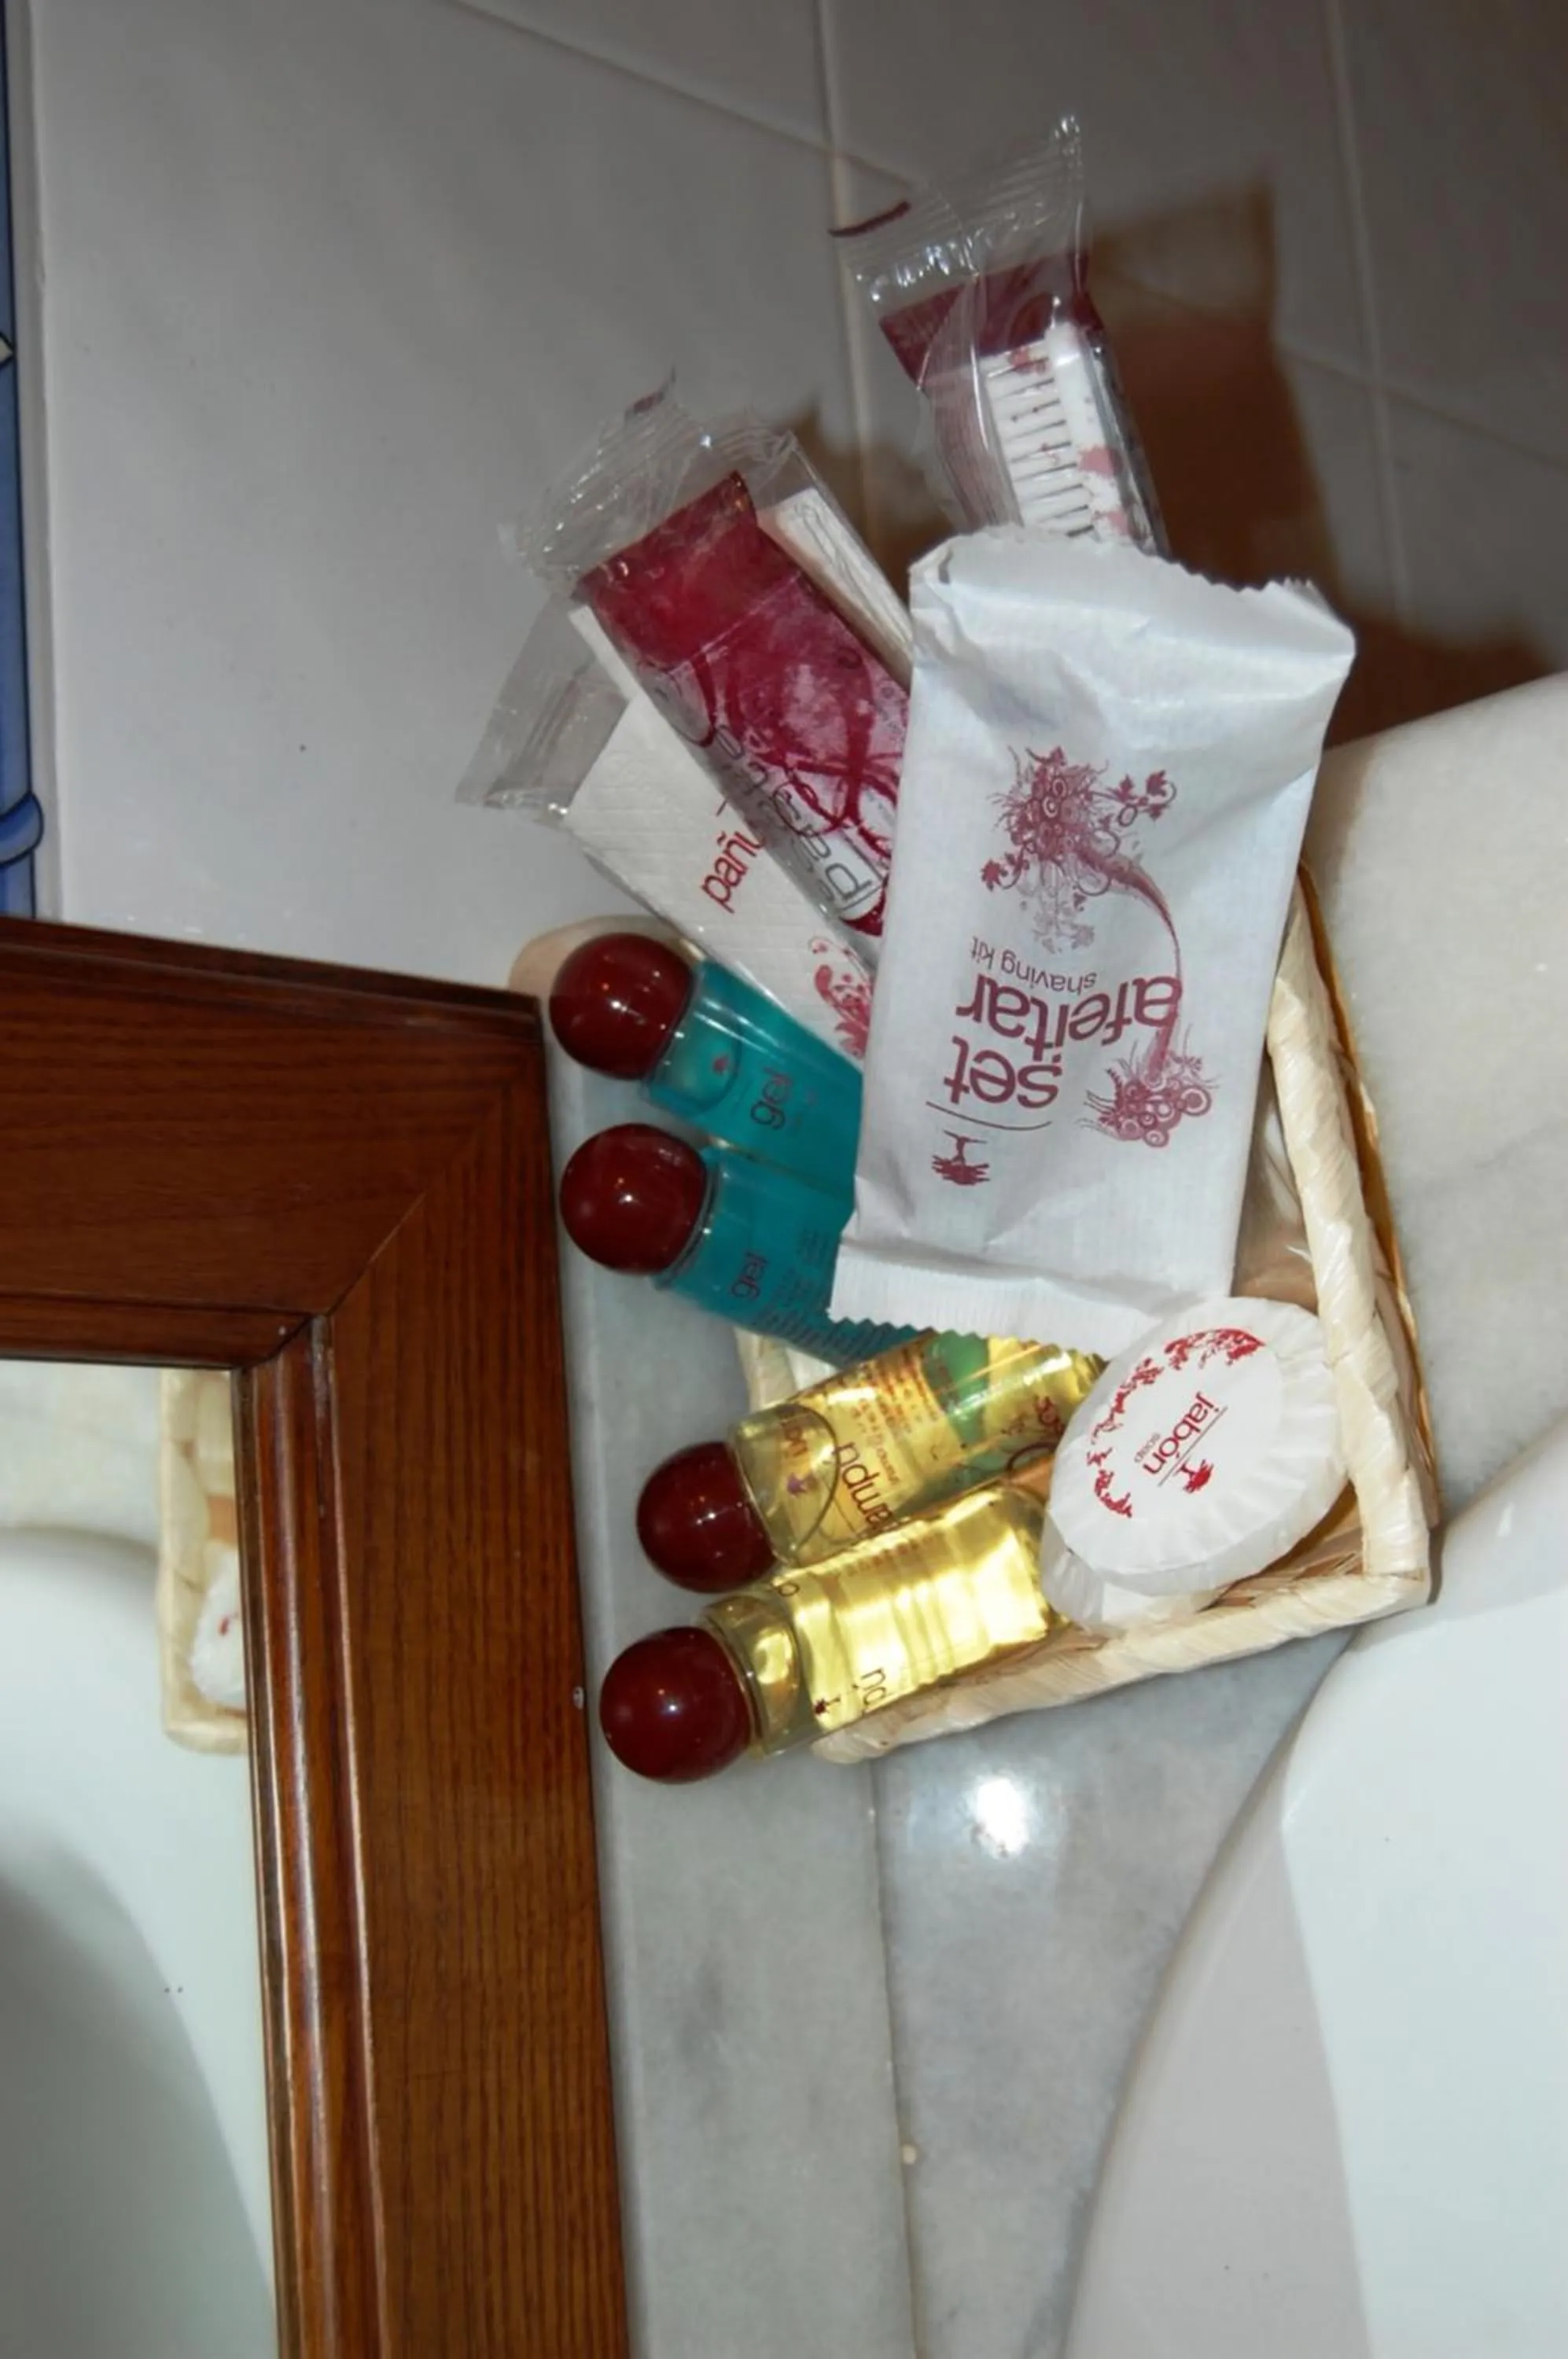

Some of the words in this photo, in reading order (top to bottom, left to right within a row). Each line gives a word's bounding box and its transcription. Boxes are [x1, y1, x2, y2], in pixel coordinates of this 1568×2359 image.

[971, 936, 995, 971] kit
[1001, 950, 1098, 995] shaving
[956, 974, 1181, 1063] afeitar
[750, 1067, 792, 1130] gel
[944, 1036, 1063, 1109] set
[731, 1251, 769, 1301] gel
[1143, 1392, 1220, 1474] jabón
